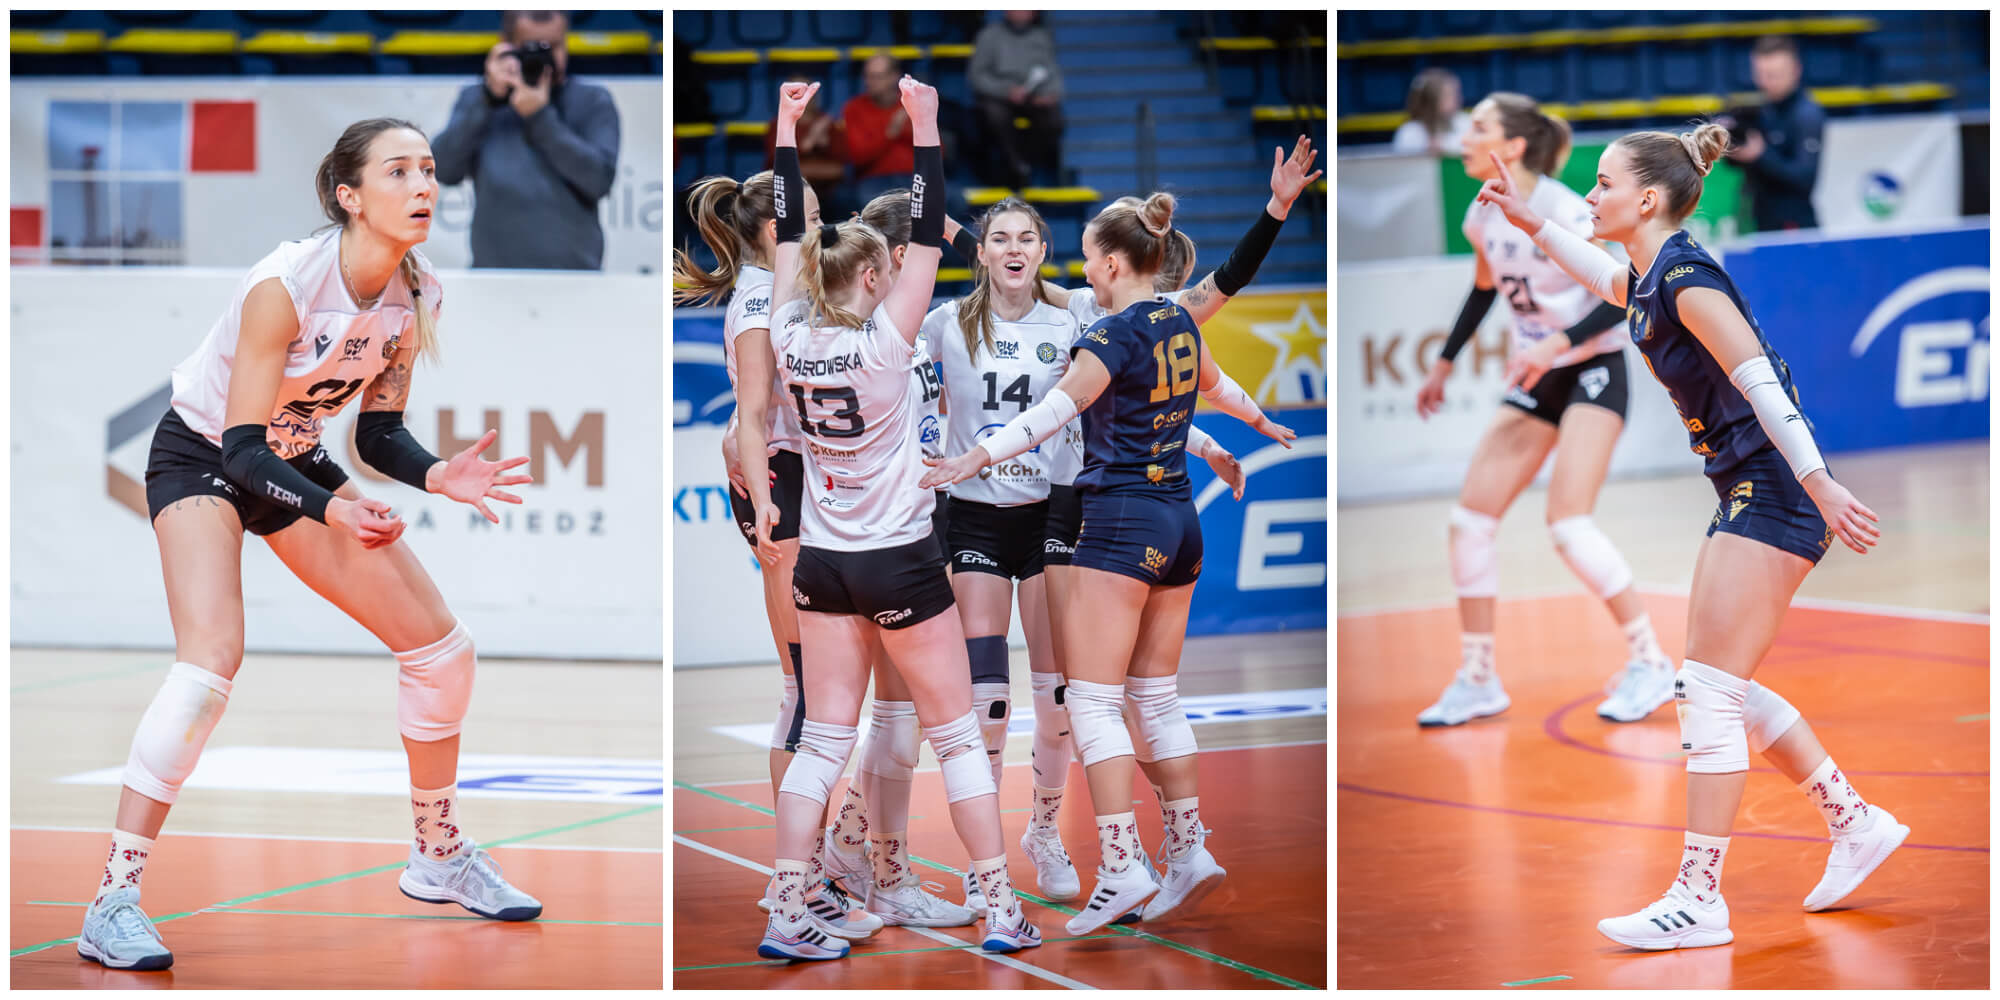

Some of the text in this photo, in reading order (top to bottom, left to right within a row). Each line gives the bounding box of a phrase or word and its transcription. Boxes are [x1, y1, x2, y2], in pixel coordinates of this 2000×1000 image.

[1502, 275, 1540, 314] 21
[914, 360, 940, 403] 19
[1149, 331, 1199, 403] 18
[282, 378, 365, 419] 21
[789, 384, 865, 438] 13
[982, 372, 1032, 412] 14
[266, 480, 303, 508] TEAM
